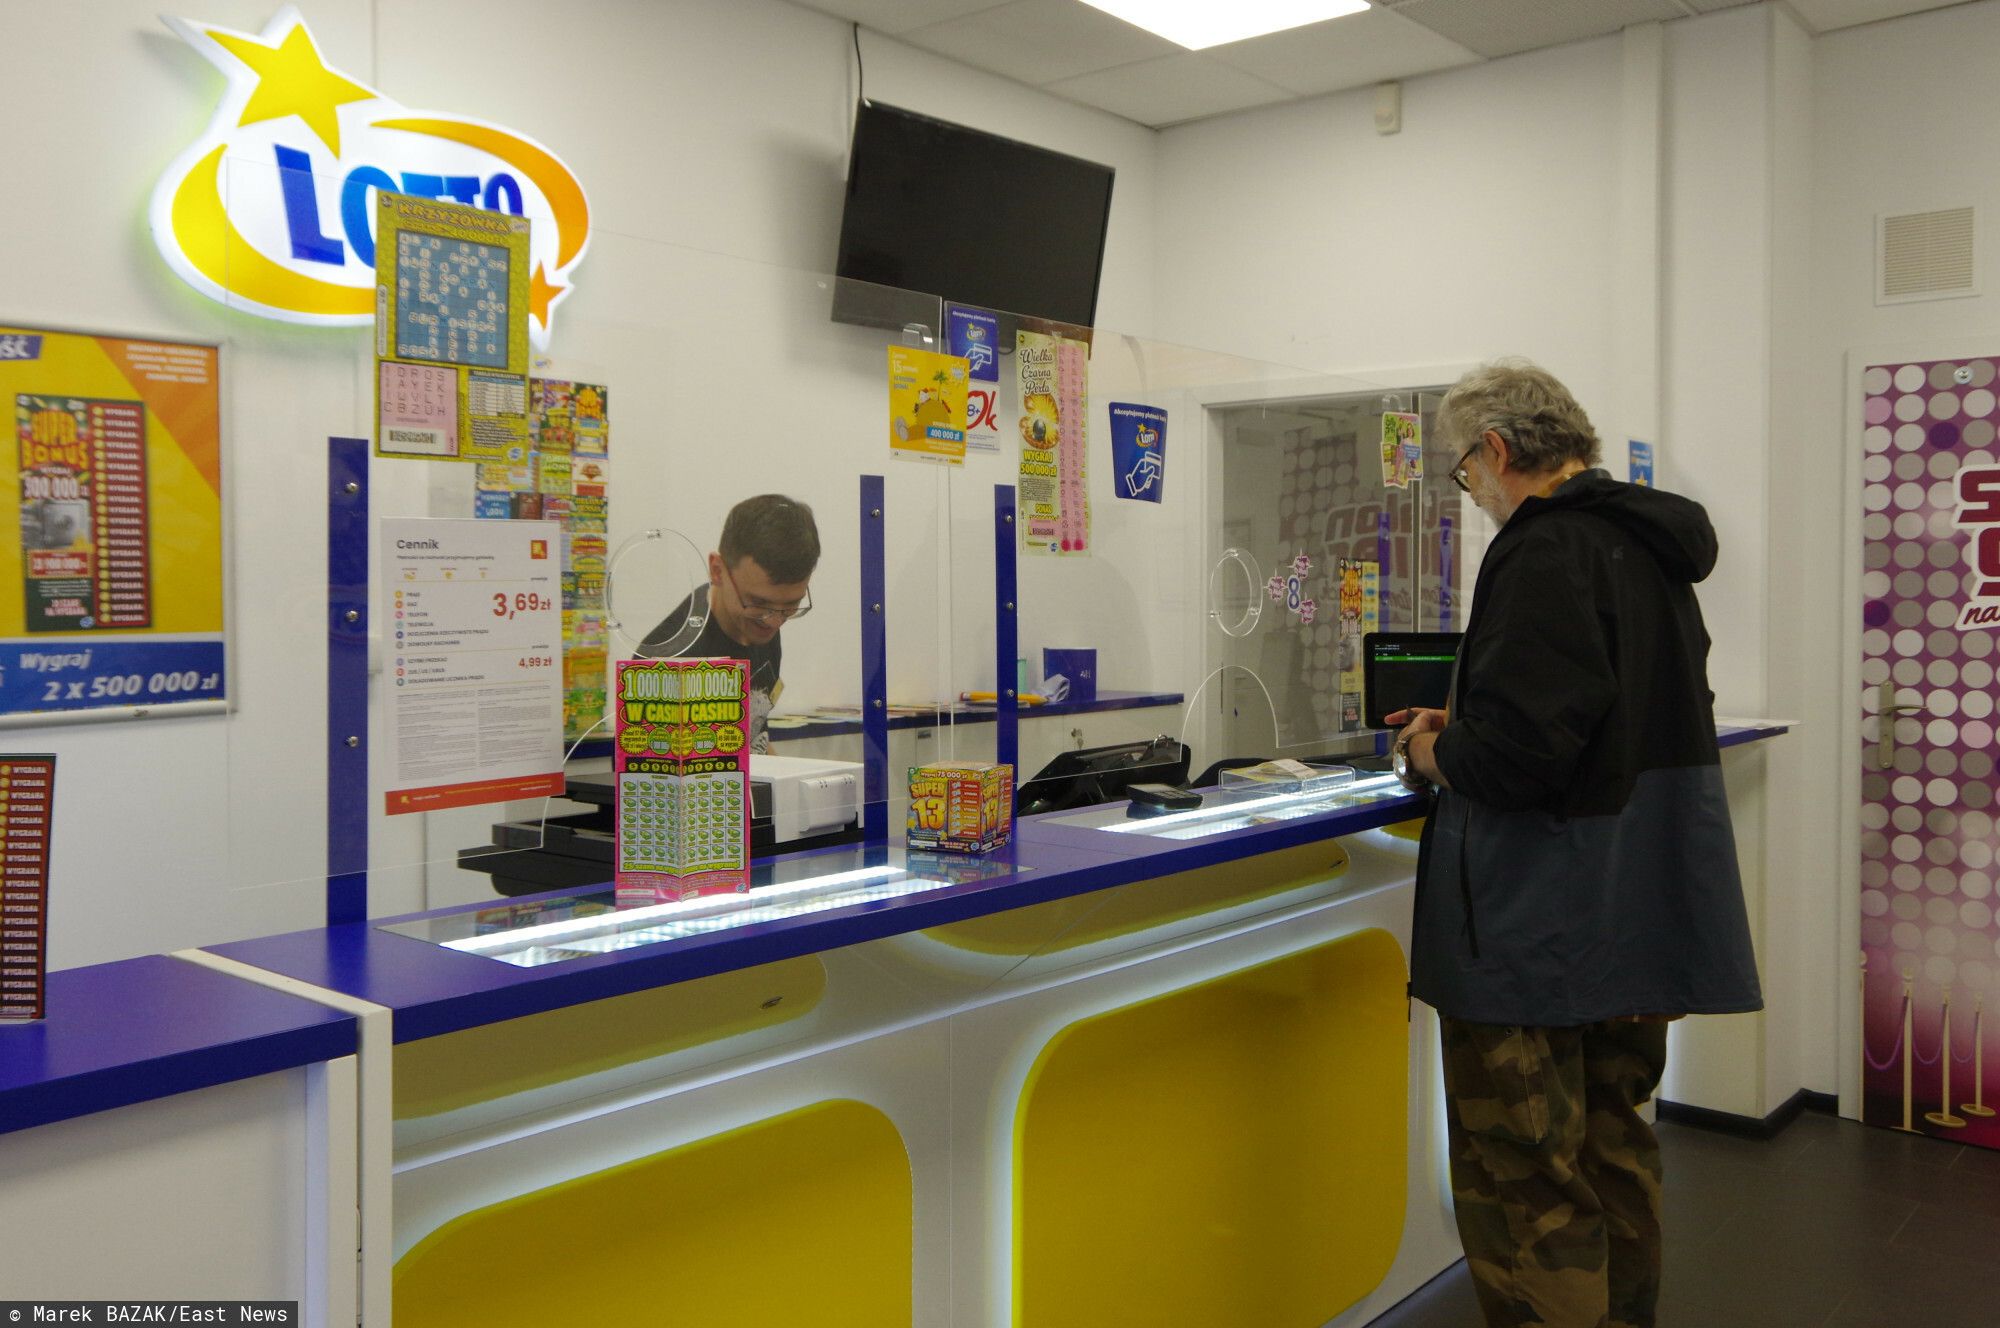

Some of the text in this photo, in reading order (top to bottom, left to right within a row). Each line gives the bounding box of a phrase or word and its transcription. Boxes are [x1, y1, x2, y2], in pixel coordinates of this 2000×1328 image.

[396, 538, 439, 549] Cennik
[19, 648, 93, 673] Wygraj
[519, 657, 541, 669] 4,99
[543, 656, 552, 667] zł
[41, 671, 220, 701] 2 x 500 000 zł
[637, 672, 660, 698] 000
[626, 702, 644, 722] W
[690, 702, 740, 722] CASHU
[910, 781, 945, 799] SUPER
[911, 798, 946, 830] 13
